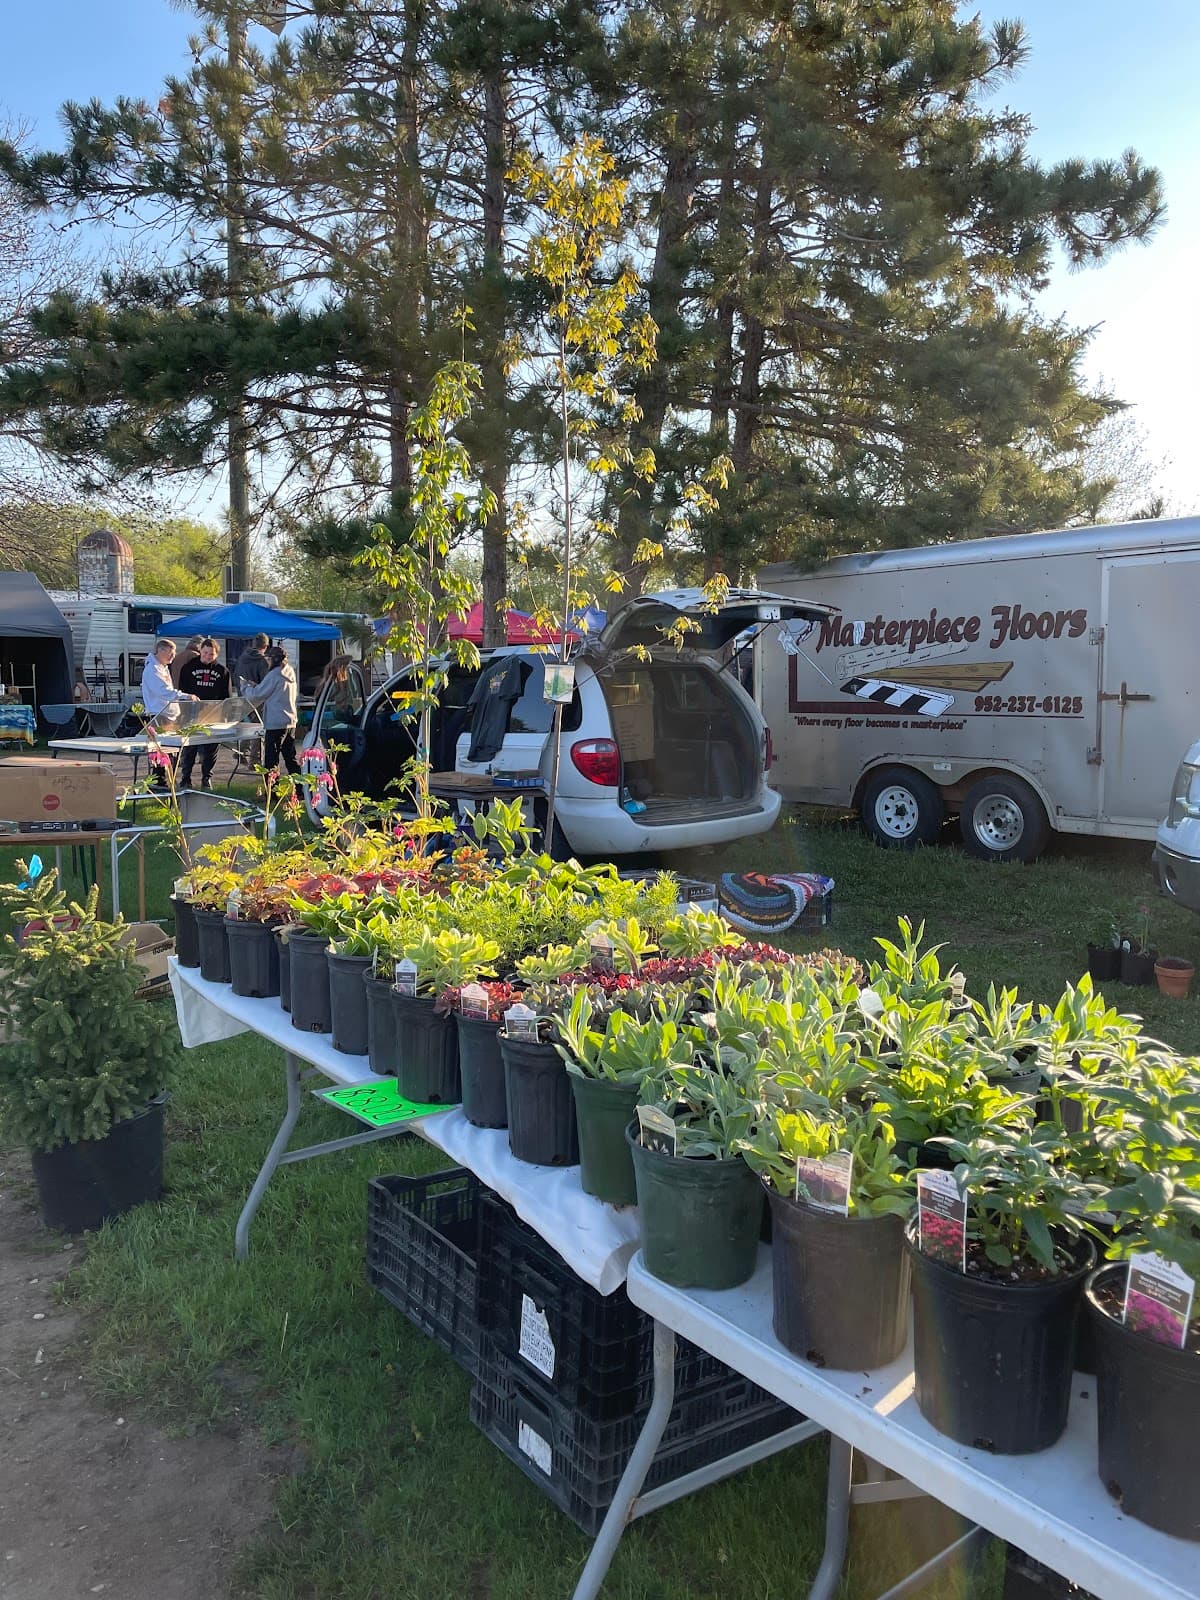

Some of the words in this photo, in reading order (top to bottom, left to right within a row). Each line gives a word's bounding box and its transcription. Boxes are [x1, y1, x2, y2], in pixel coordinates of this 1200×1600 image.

[816, 608, 981, 653] Masterpiece
[990, 604, 1087, 649] Floors
[974, 695, 1083, 713] 952-237-6125
[822, 718, 843, 729] every
[845, 717, 864, 729] floor
[866, 717, 900, 728] becomes
[902, 720, 908, 728] a
[911, 719, 967, 732] masterpiece"
